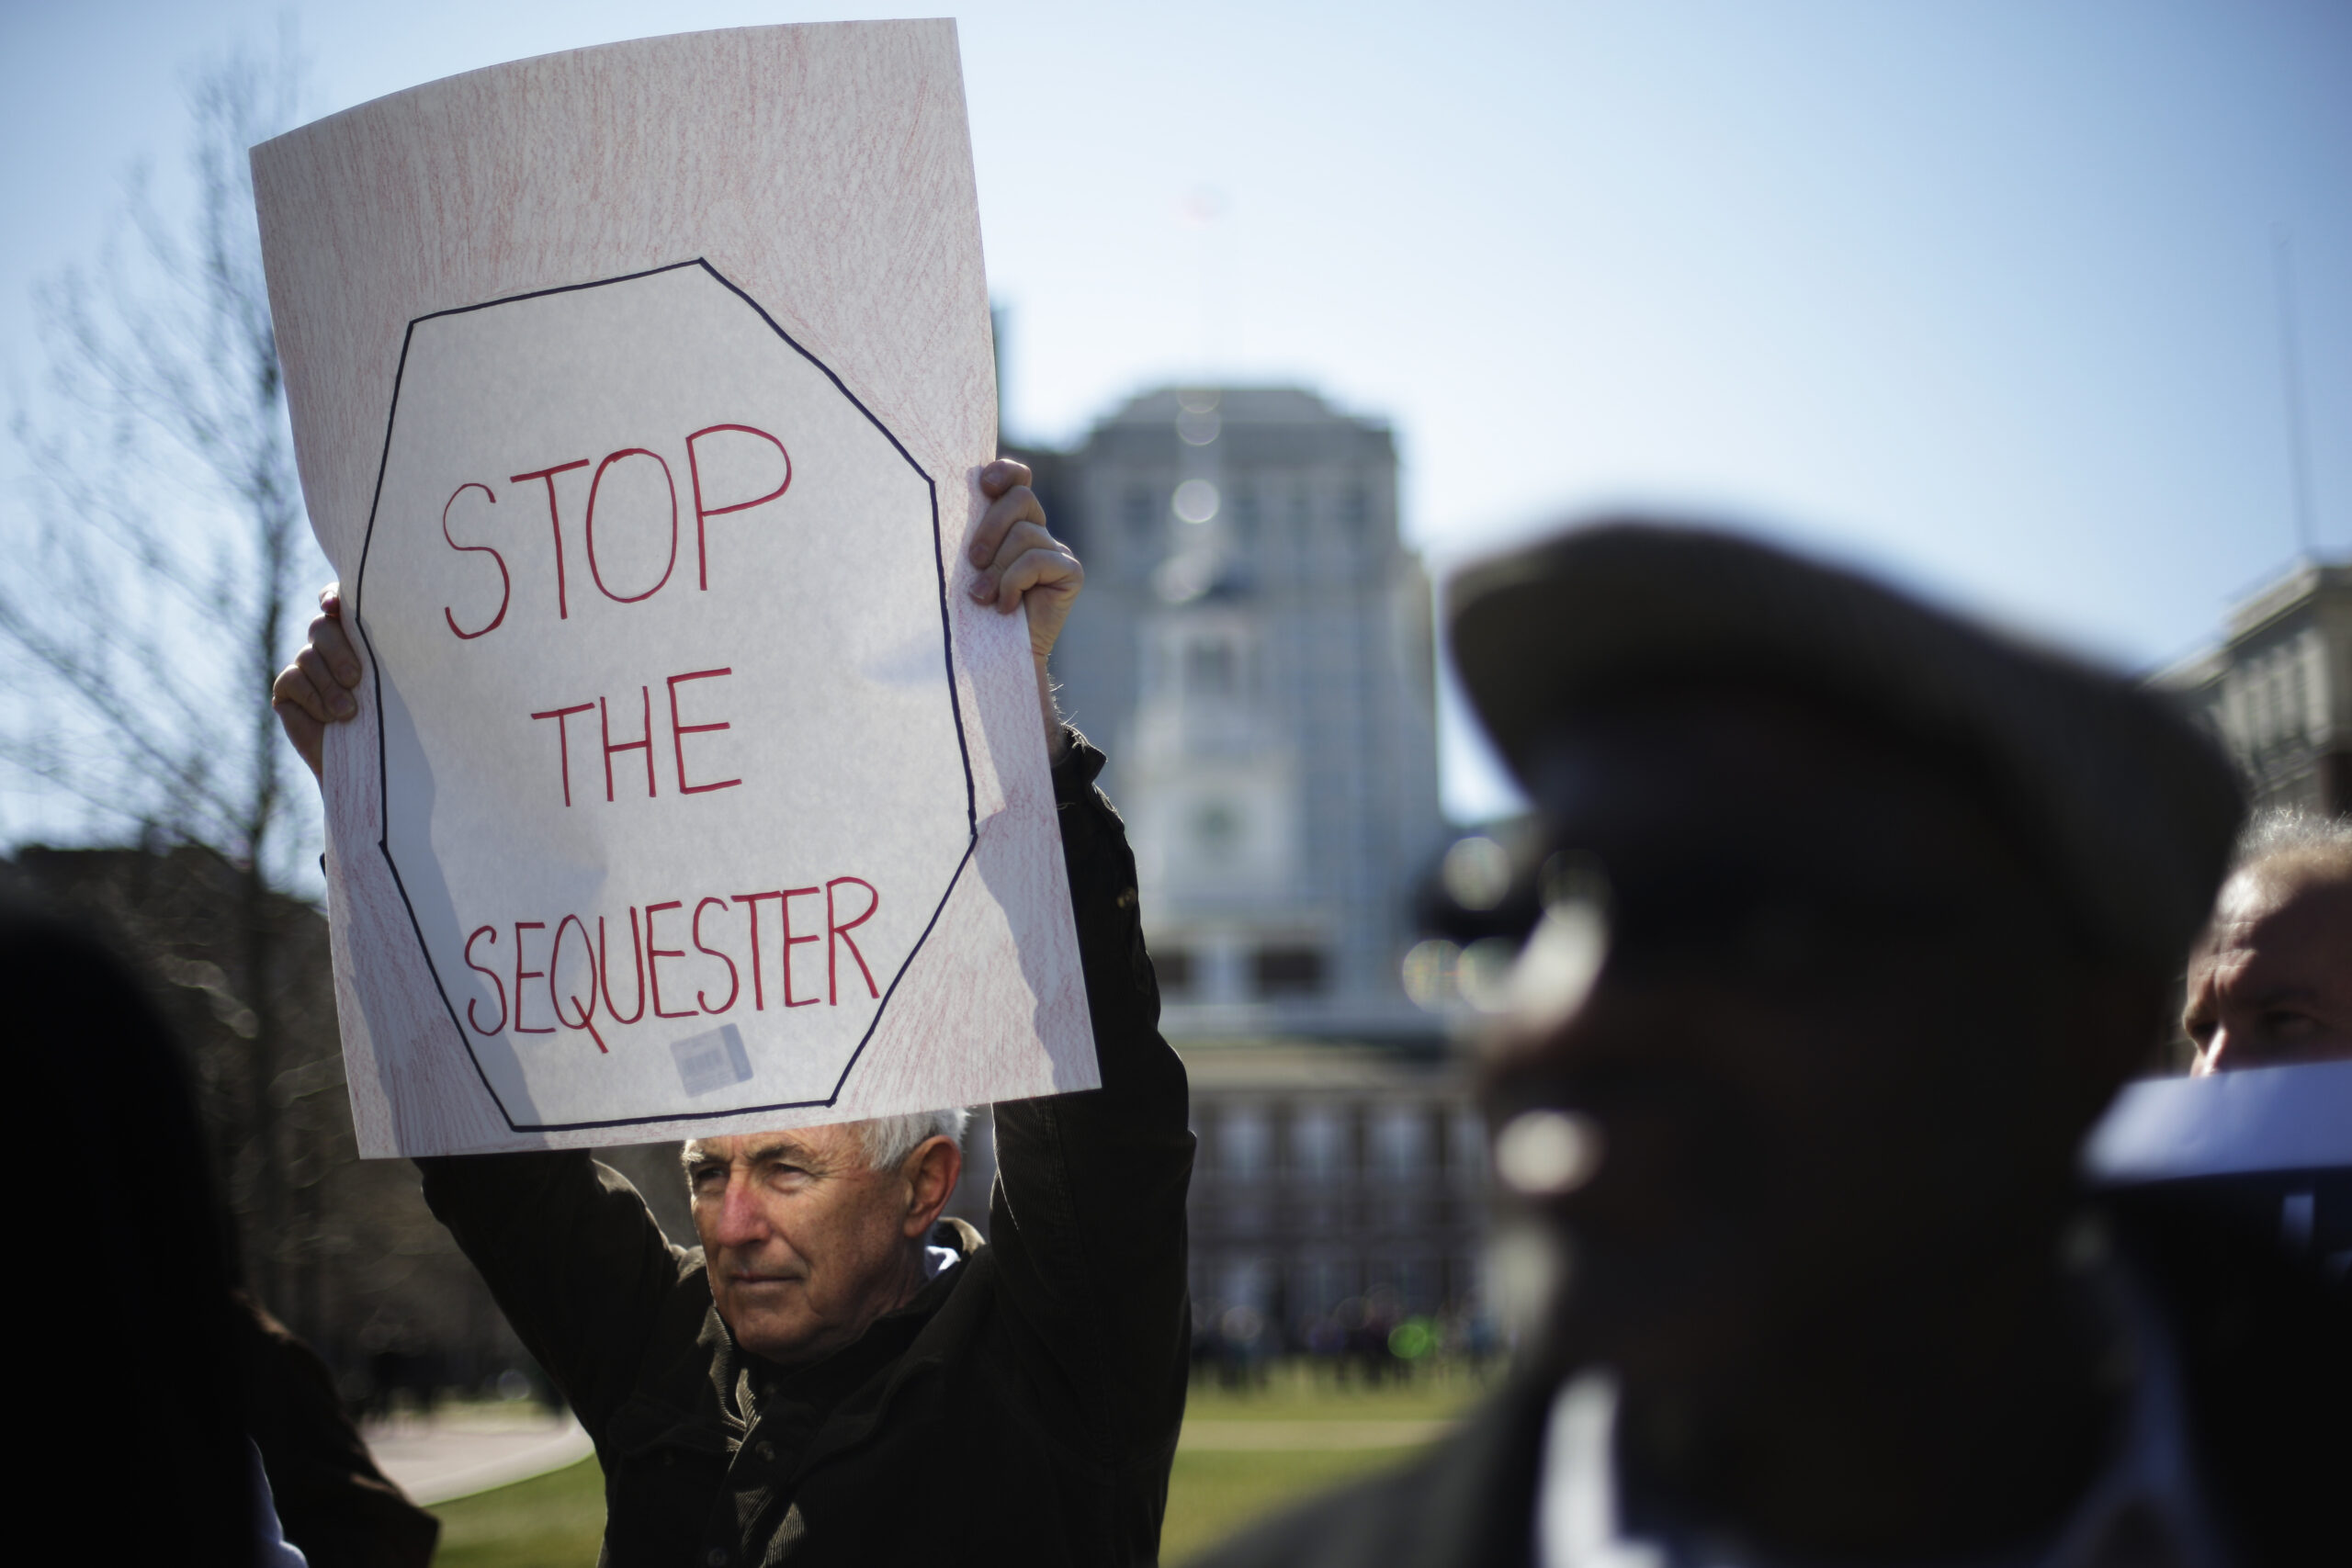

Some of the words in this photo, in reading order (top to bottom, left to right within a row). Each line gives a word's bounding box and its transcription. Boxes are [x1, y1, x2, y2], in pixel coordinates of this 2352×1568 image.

[443, 423, 792, 640] STOP
[531, 667, 742, 807] THE
[465, 876, 880, 1054] SEQUESTER
